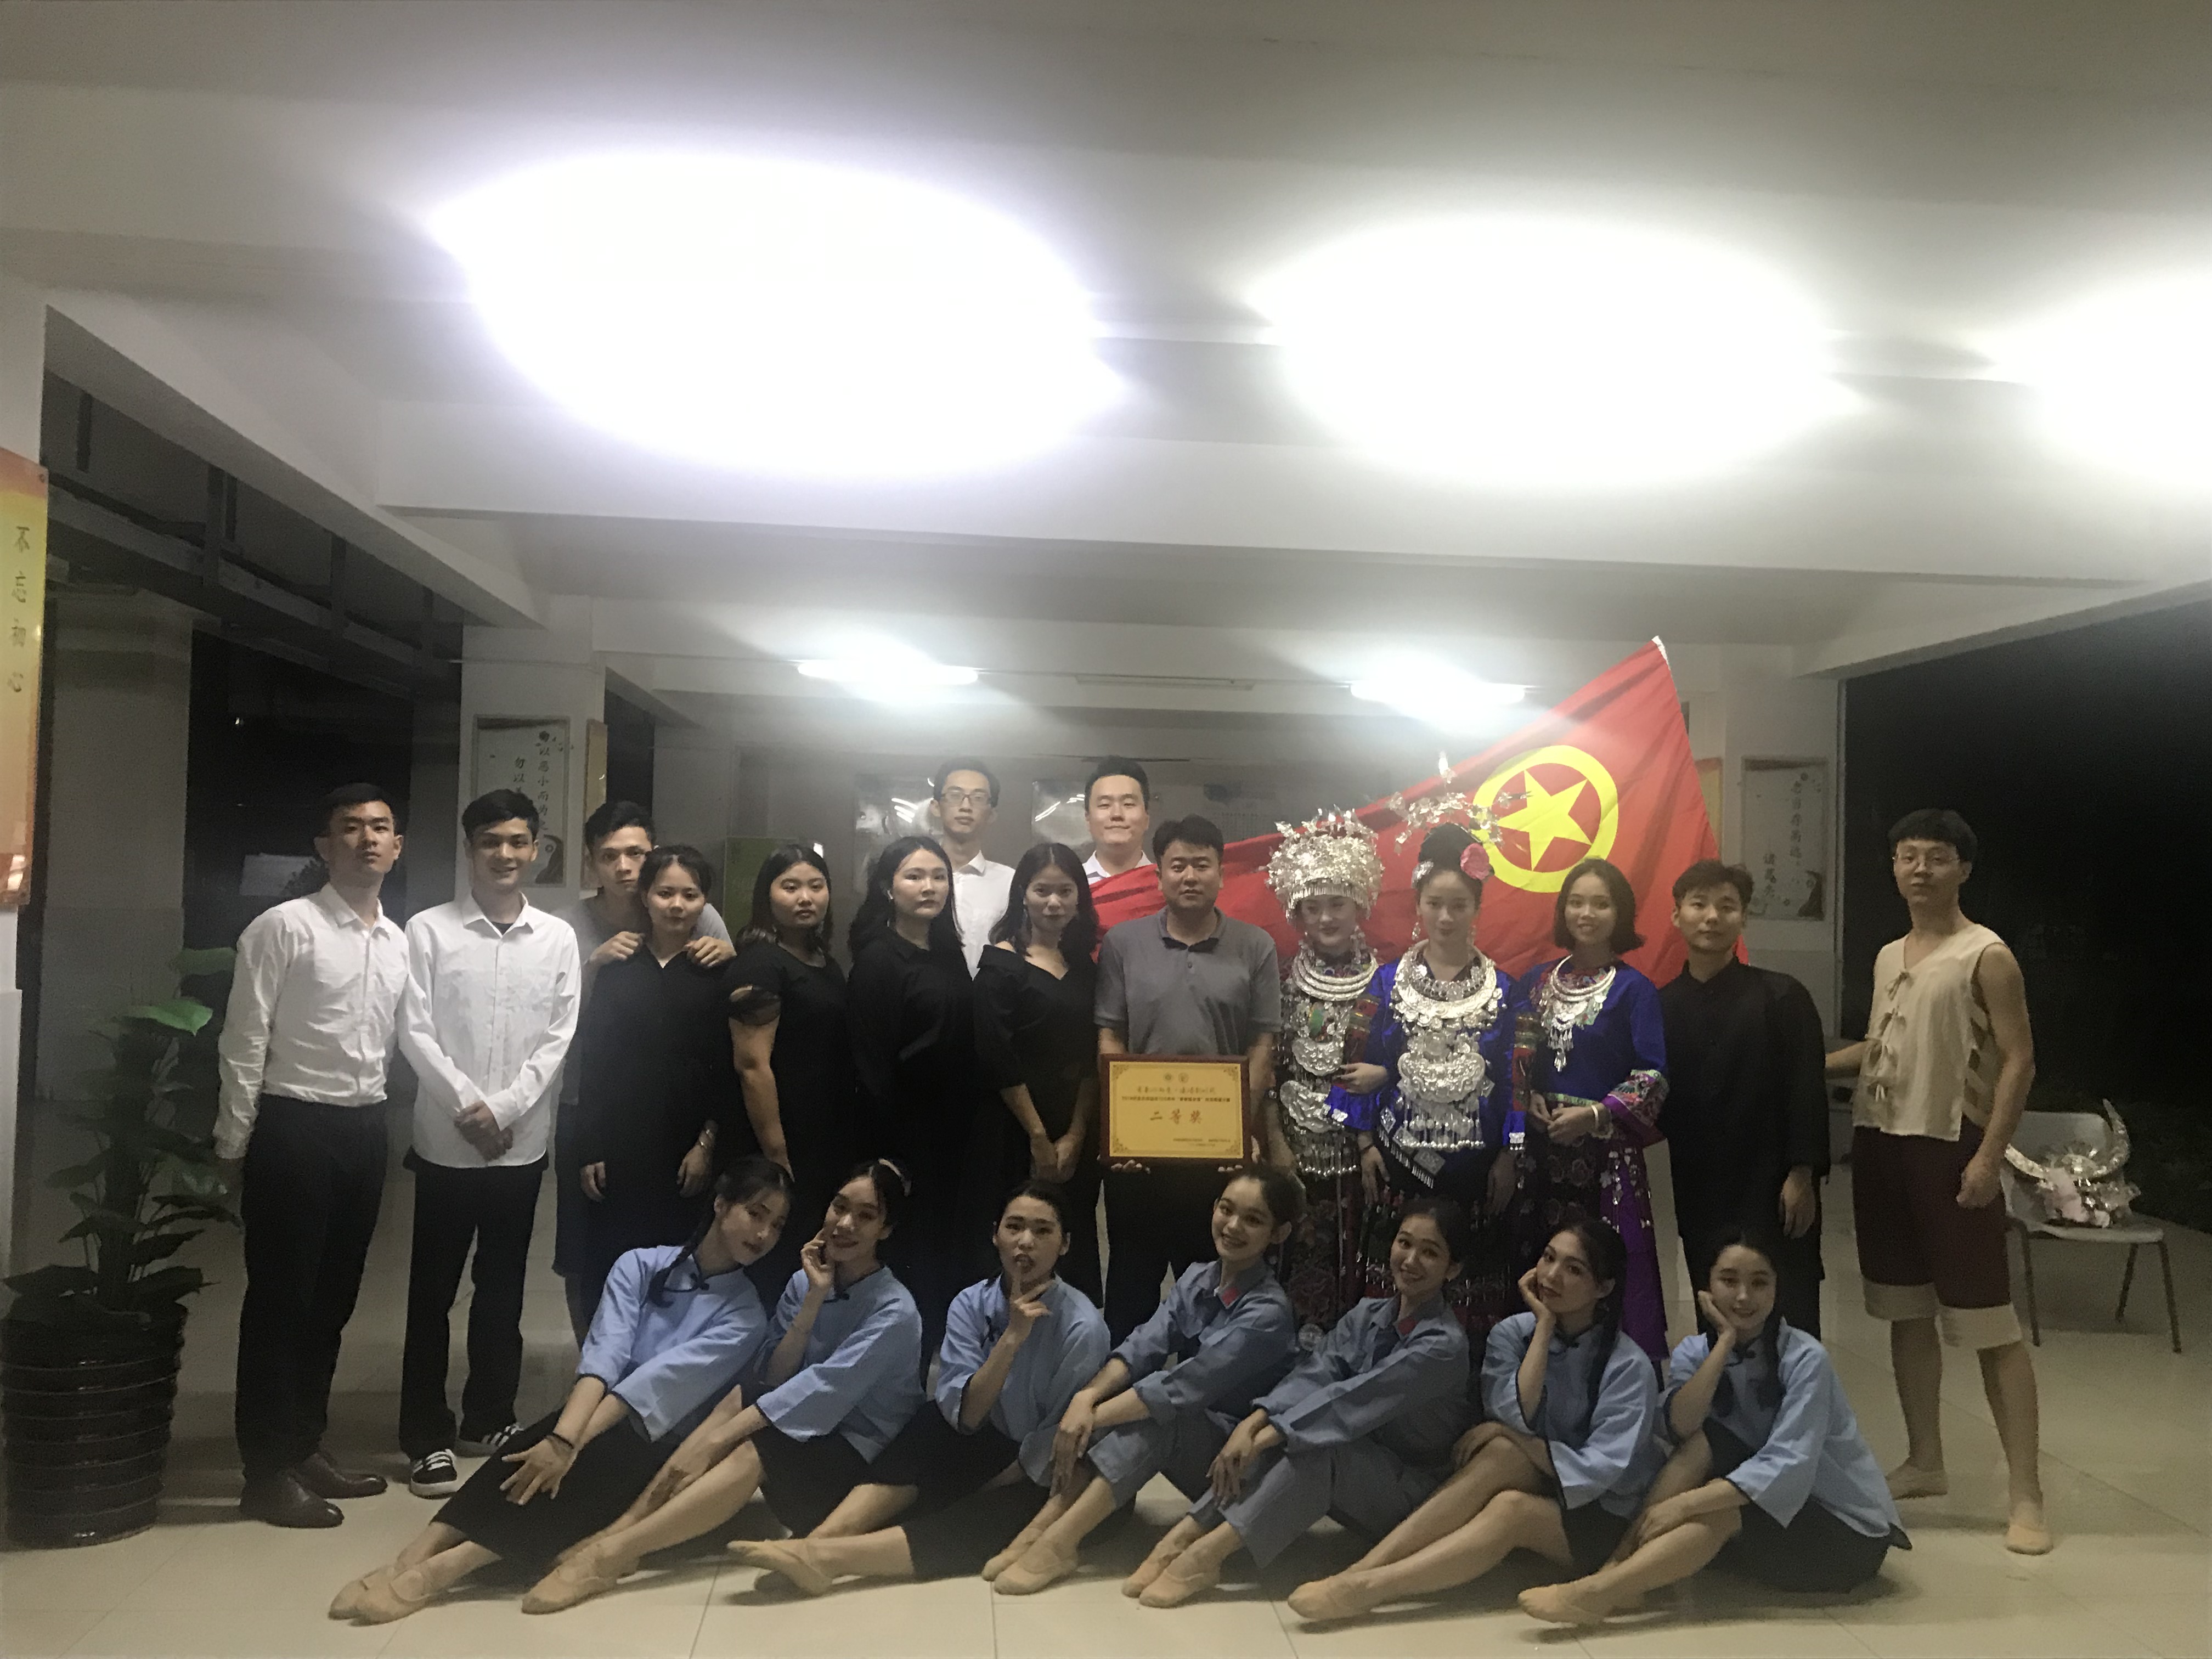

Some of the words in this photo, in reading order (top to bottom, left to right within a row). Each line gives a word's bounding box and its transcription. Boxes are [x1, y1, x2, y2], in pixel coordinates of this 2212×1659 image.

[8, 526, 30, 693] 不忘初心
[1150, 1108, 1202, 1124] 二等奖
